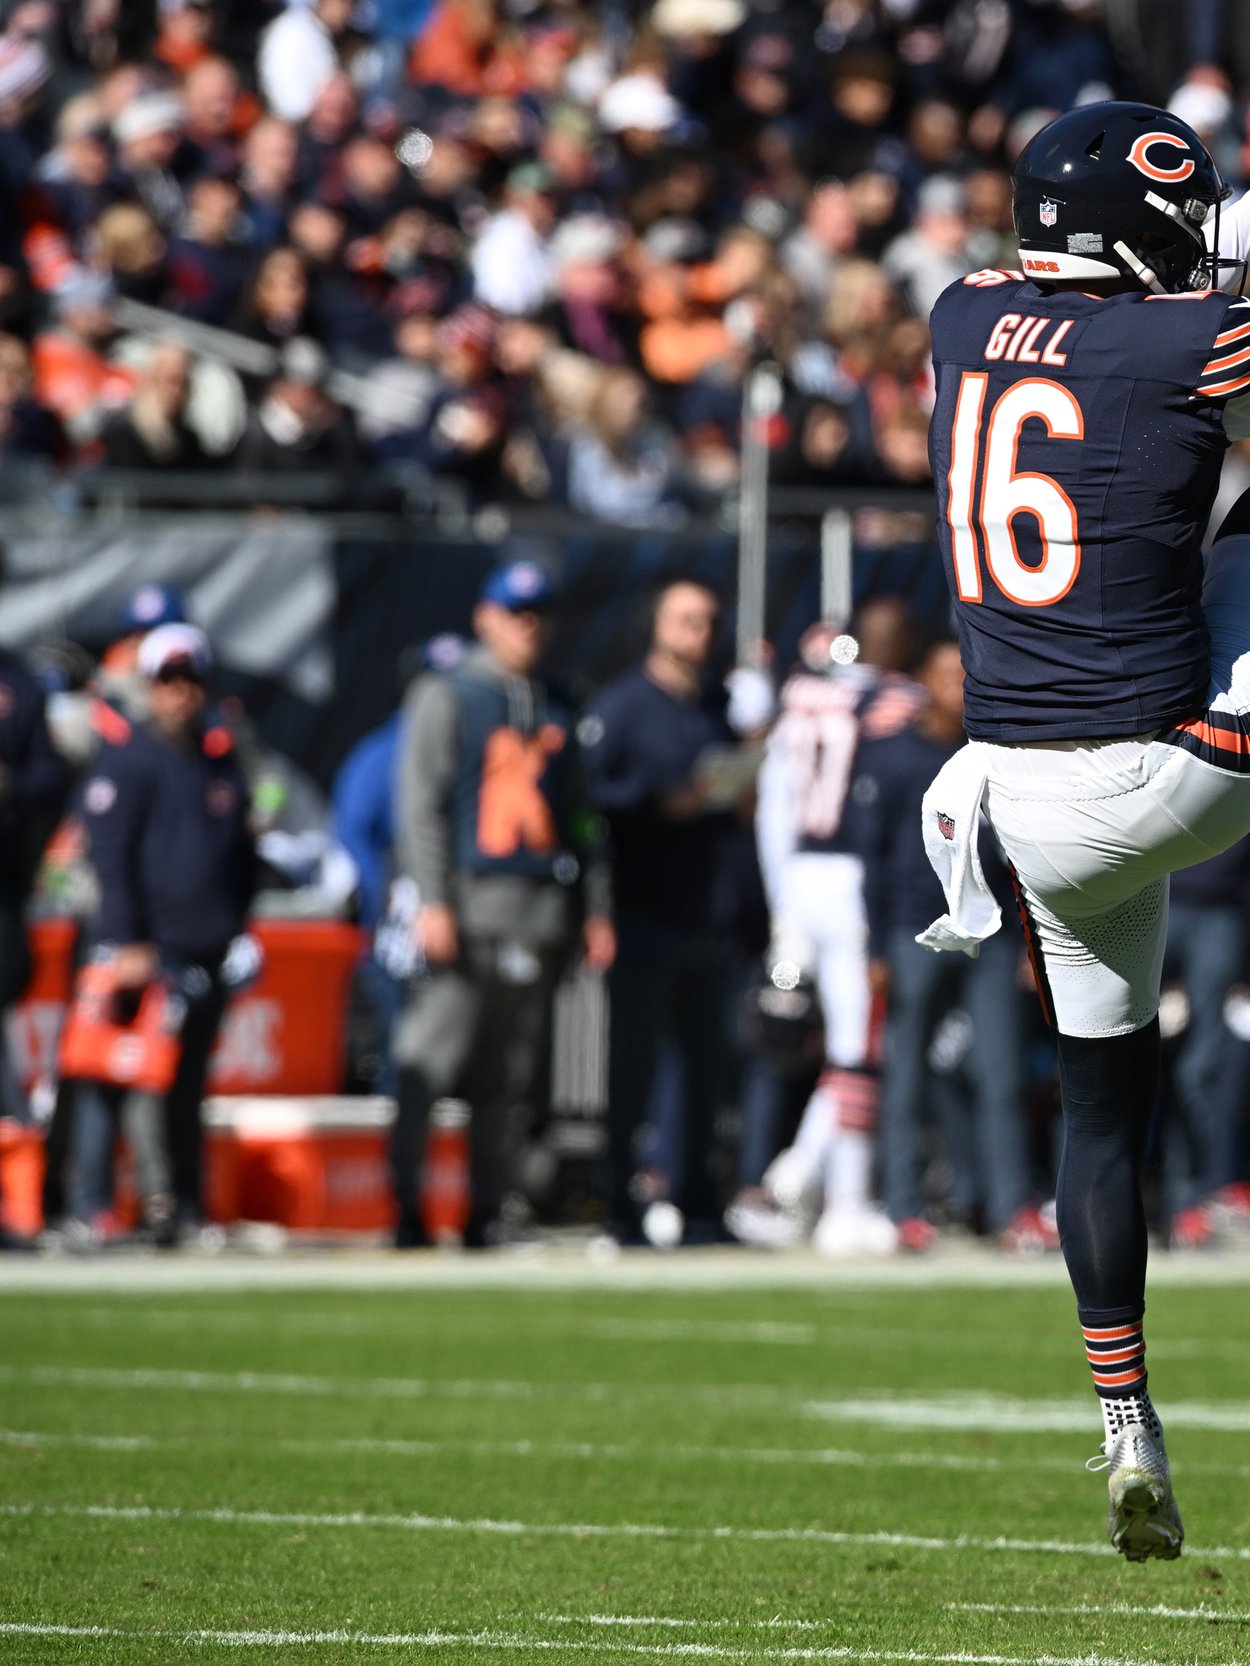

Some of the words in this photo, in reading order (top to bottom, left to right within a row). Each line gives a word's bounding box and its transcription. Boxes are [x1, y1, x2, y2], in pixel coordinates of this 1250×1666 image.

[1022, 258, 1061, 273] ARS
[984, 313, 1075, 367] GILL
[948, 371, 1085, 607] 16
